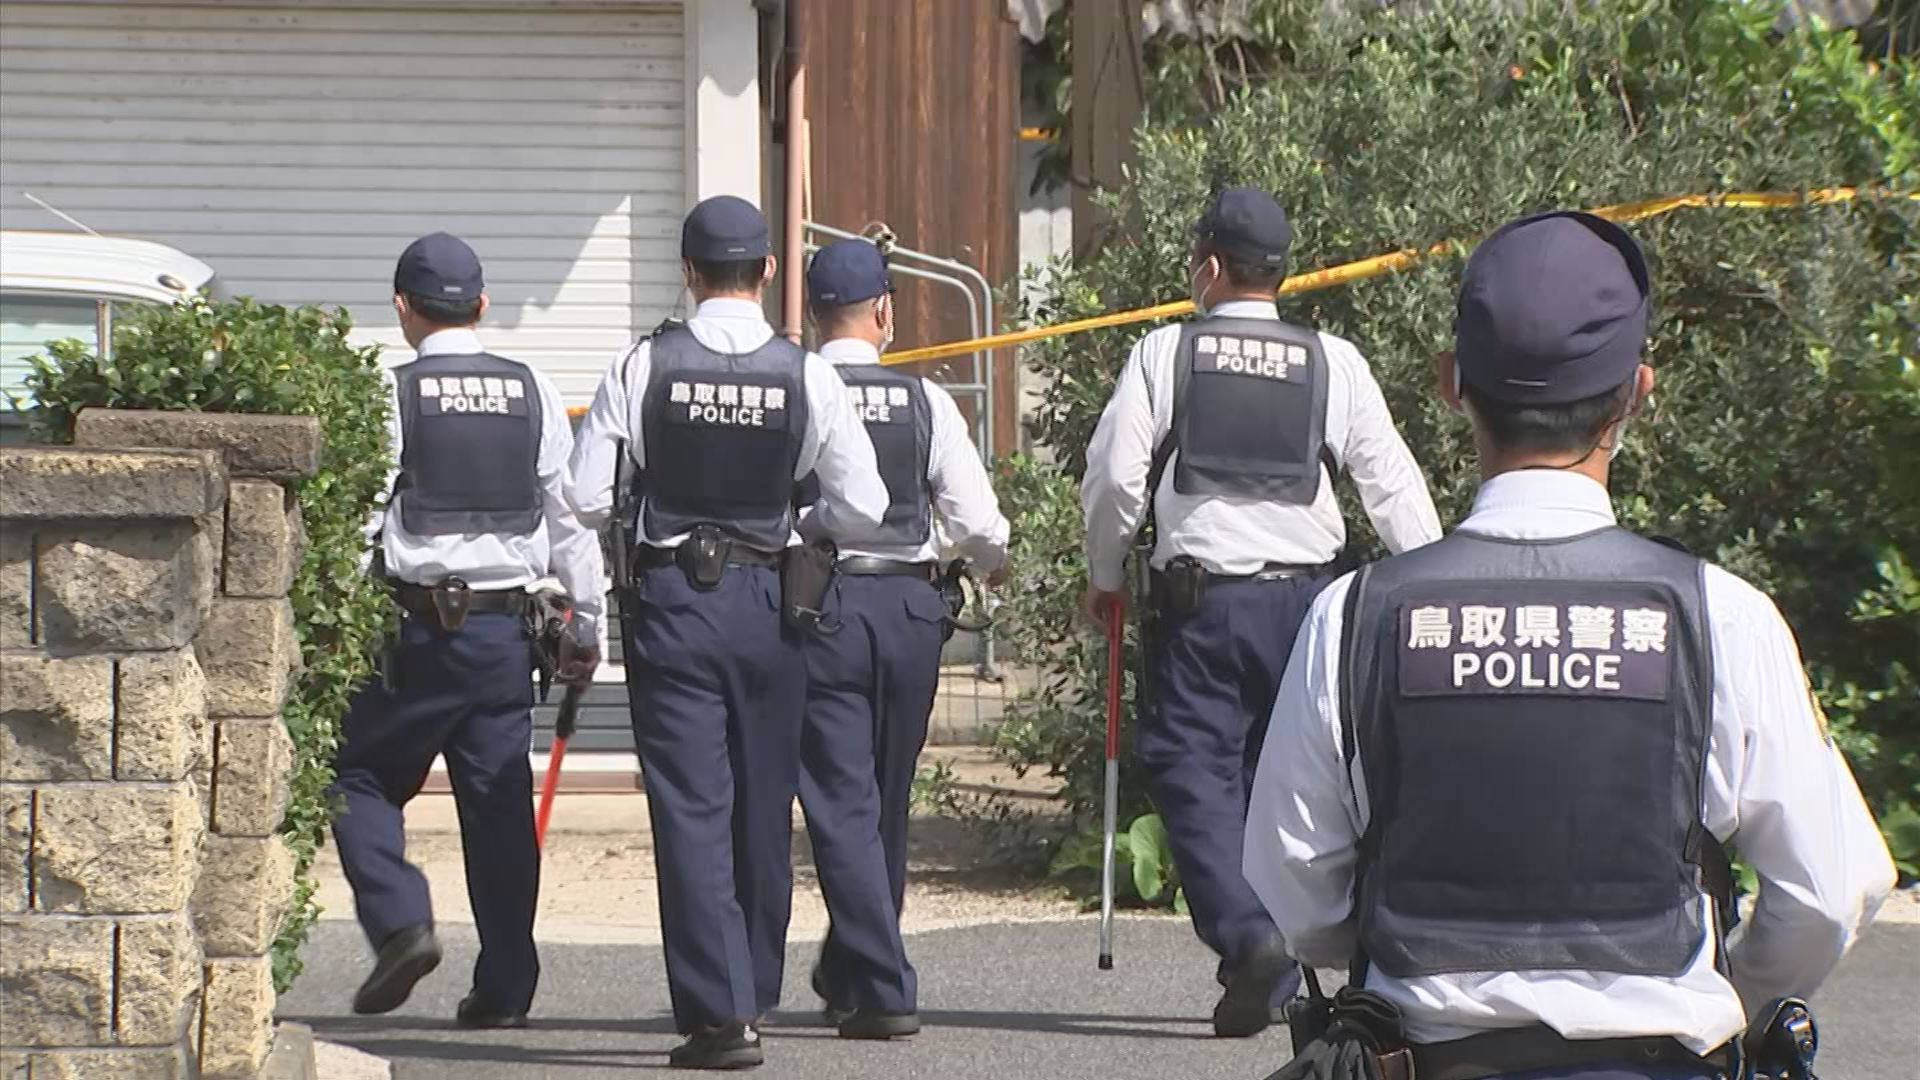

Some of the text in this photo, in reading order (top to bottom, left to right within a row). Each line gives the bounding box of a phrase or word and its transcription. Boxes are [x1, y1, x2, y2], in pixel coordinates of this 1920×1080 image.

[1216, 355, 1288, 378] POLICE
[441, 397, 509, 413] POLICE
[689, 404, 764, 425] POLICE
[859, 404, 891, 422] ICE
[1408, 605, 1667, 653] 鳥取県警察
[1453, 651, 1621, 690] POLICE
